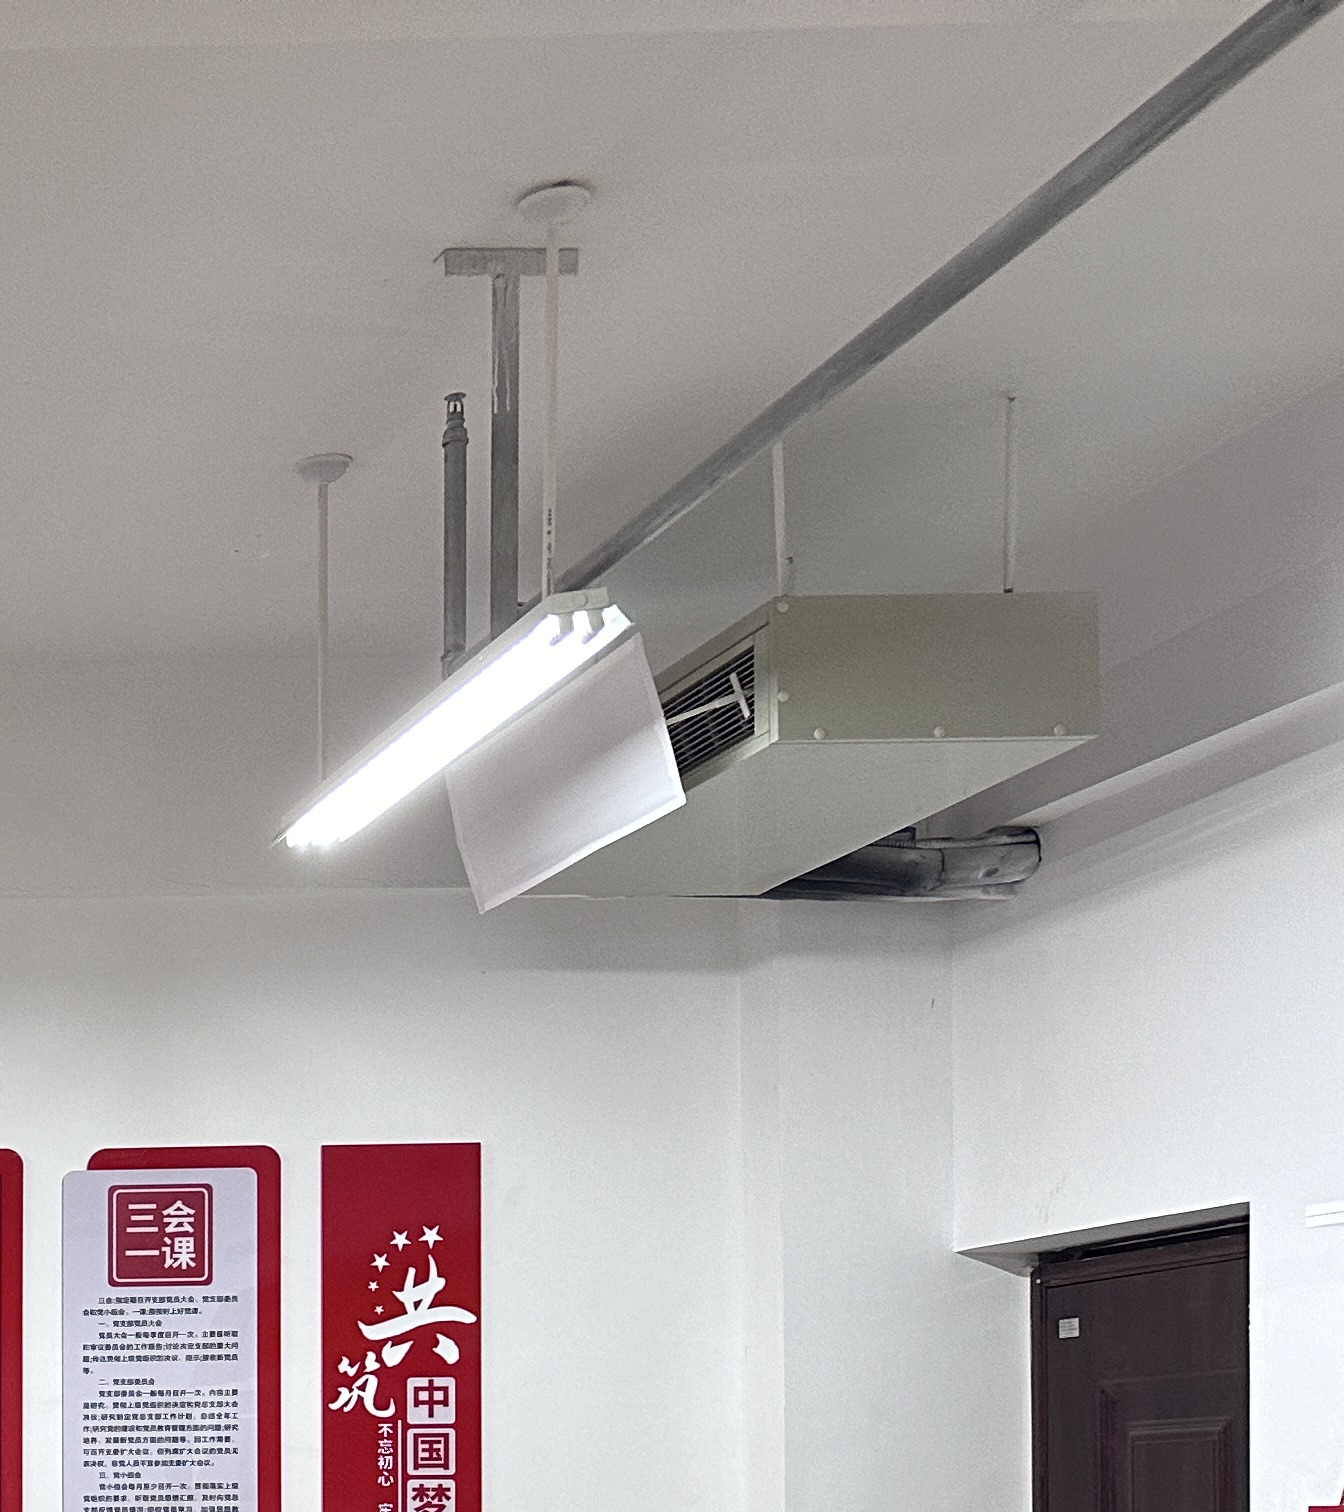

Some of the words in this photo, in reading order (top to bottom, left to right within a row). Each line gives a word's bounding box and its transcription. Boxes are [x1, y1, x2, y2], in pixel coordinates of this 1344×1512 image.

[125, 1200, 198, 1234] 三会
[124, 1237, 198, 1271] 一课
[376, 1422, 395, 1488] 不忘初心
